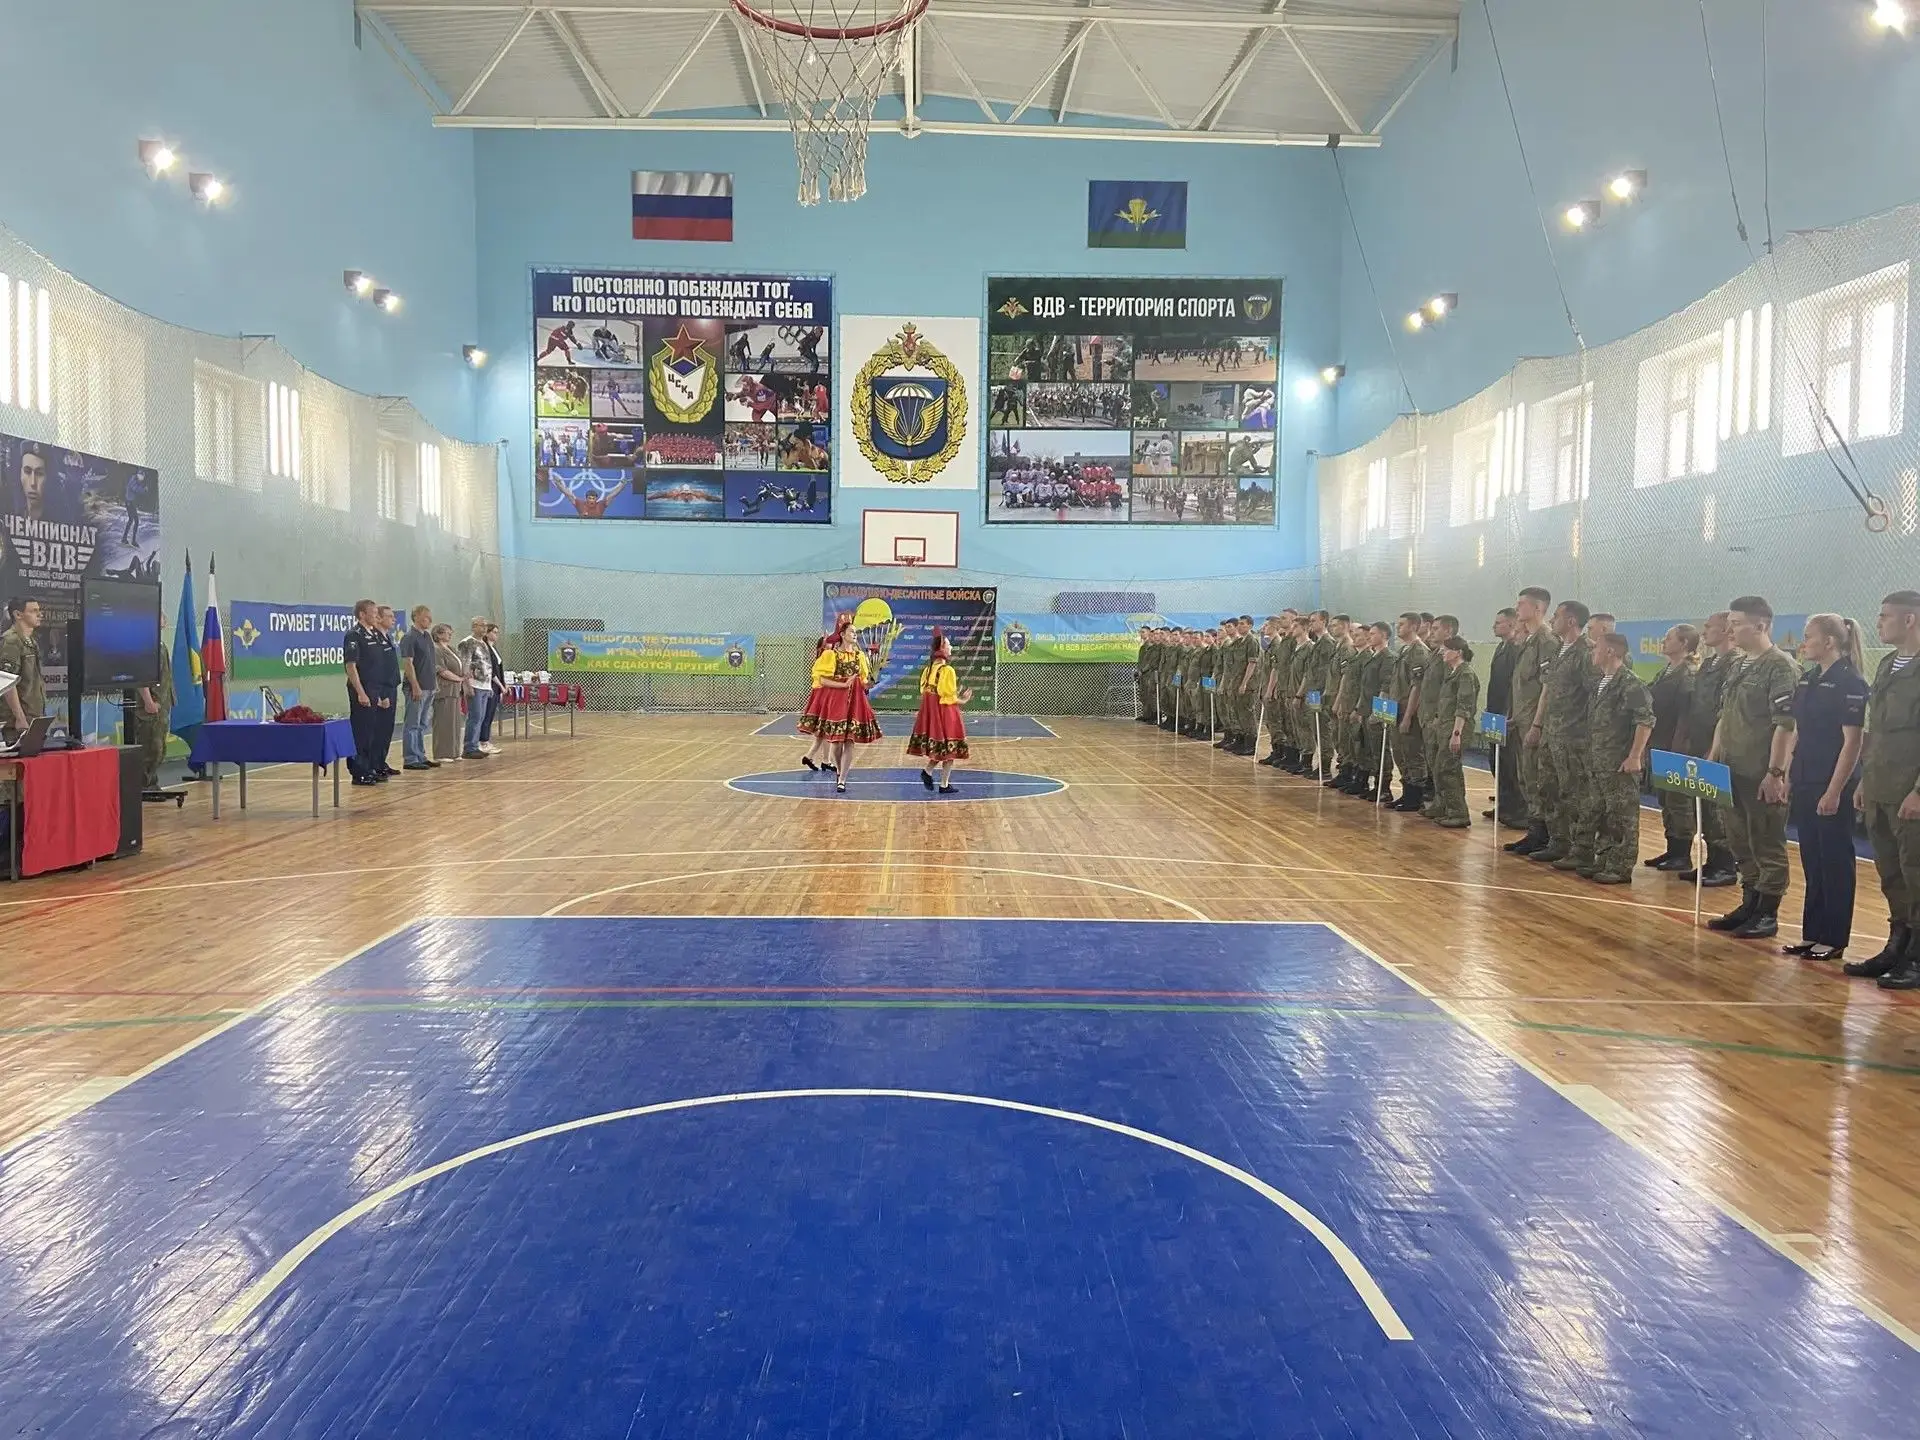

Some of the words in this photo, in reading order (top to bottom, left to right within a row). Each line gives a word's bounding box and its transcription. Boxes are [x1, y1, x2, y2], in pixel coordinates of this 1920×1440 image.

[572, 276, 665, 296] ПОСТОЯННО
[668, 279, 760, 299] ПОБЕЖДАЕТ
[762, 282, 793, 301] ТОТ,
[552, 295, 582, 312] КТО
[585, 296, 677, 315] ПОСТОЯННО
[680, 299, 772, 319] ПОБЕЖДАЕТ
[774, 301, 814, 319] СЕБЯ
[1033, 296, 1065, 318] ВДВ
[1079, 296, 1174, 317] ТЕРРИТОРИЯ
[1177, 298, 1236, 318] СПОРТА
[668, 373, 694, 400] ЦСКА
[4, 514, 98, 545] ЧЕМПИОНАТ
[31, 540, 77, 571] ВДВ
[946, 588, 981, 600] ВОЙСКА
[269, 612, 316, 632] ПРИВЕТ
[587, 660, 610, 669] КАК
[613, 660, 672, 670] СДАЮТСЯ
[675, 662, 721, 671] ДРУГИЕ
[1666, 770, 1681, 786] 38
[1684, 777, 1696, 789] гв
[1698, 777, 1718, 799] бру
